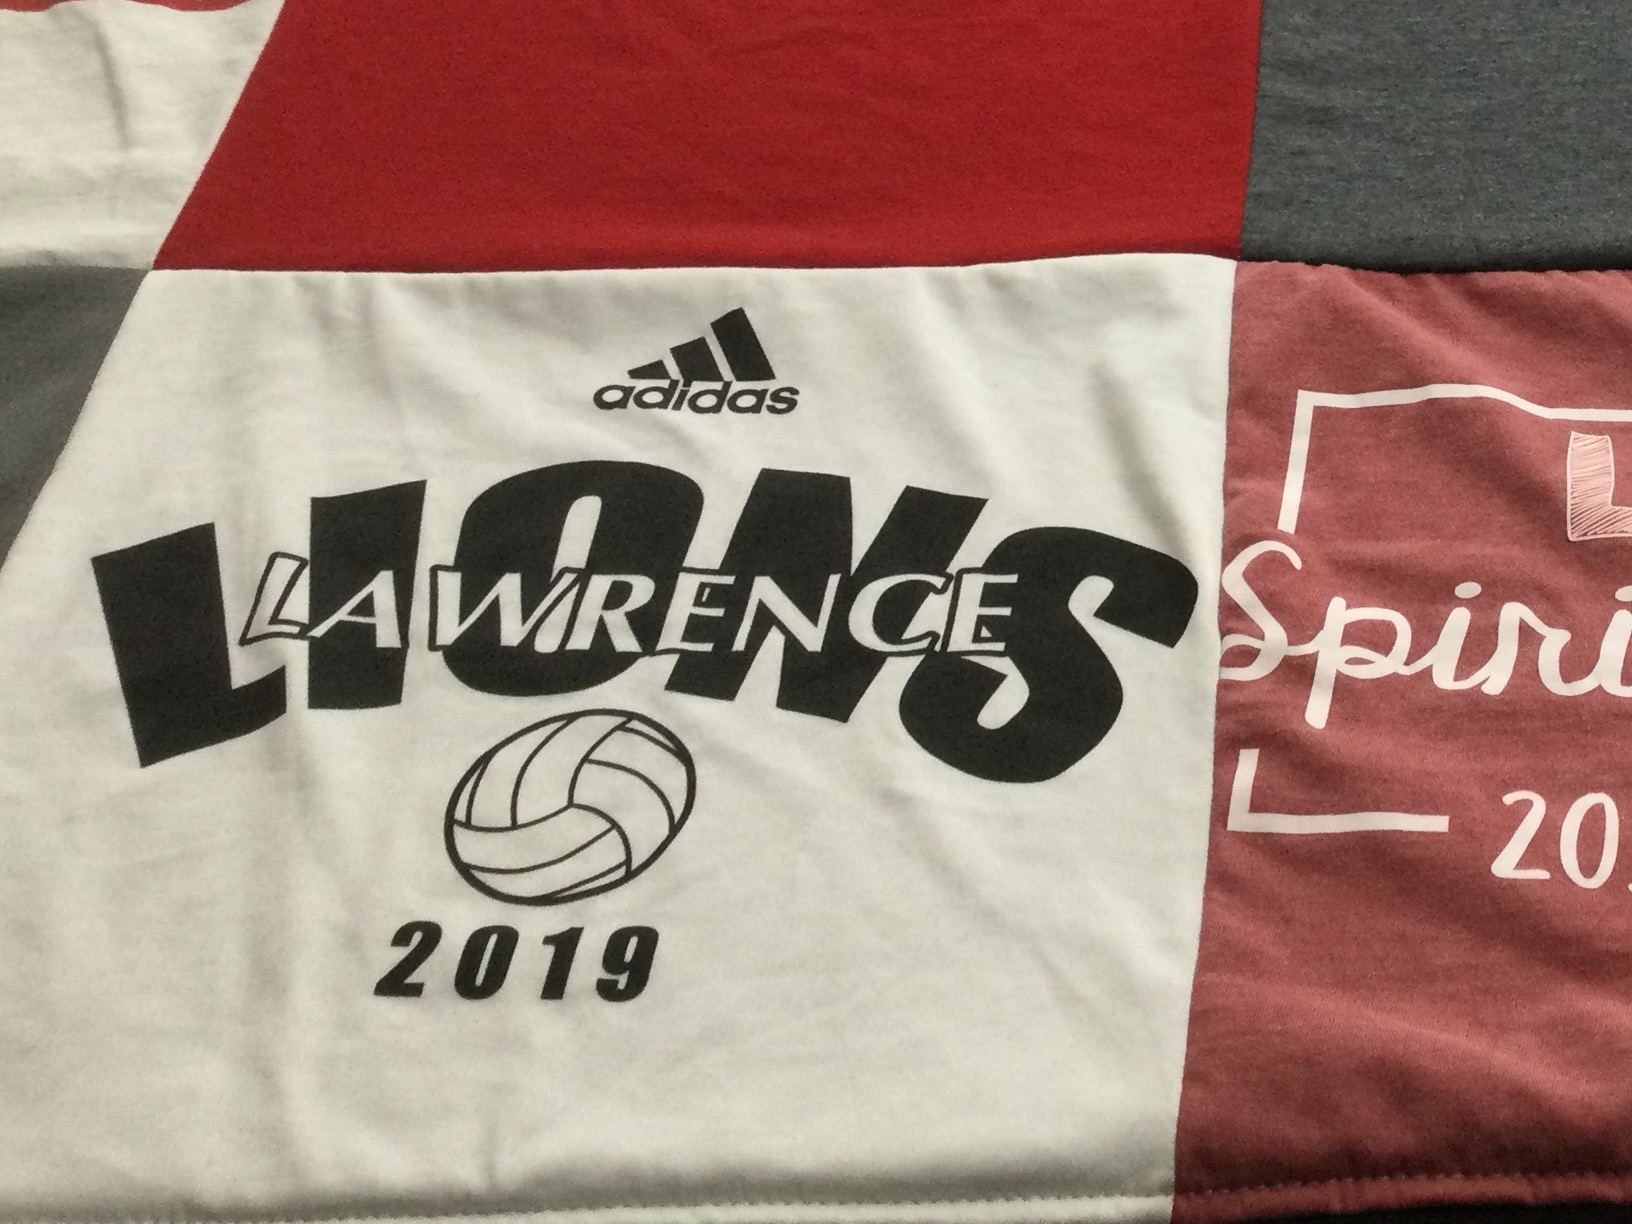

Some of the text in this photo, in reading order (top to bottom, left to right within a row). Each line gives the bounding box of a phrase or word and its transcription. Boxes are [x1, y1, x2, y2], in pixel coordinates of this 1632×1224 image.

[592, 374, 802, 417] adidas
[90, 458, 1199, 784] LIONS
[239, 551, 1020, 658] LAWRENCE
[373, 919, 662, 1003] 2019
